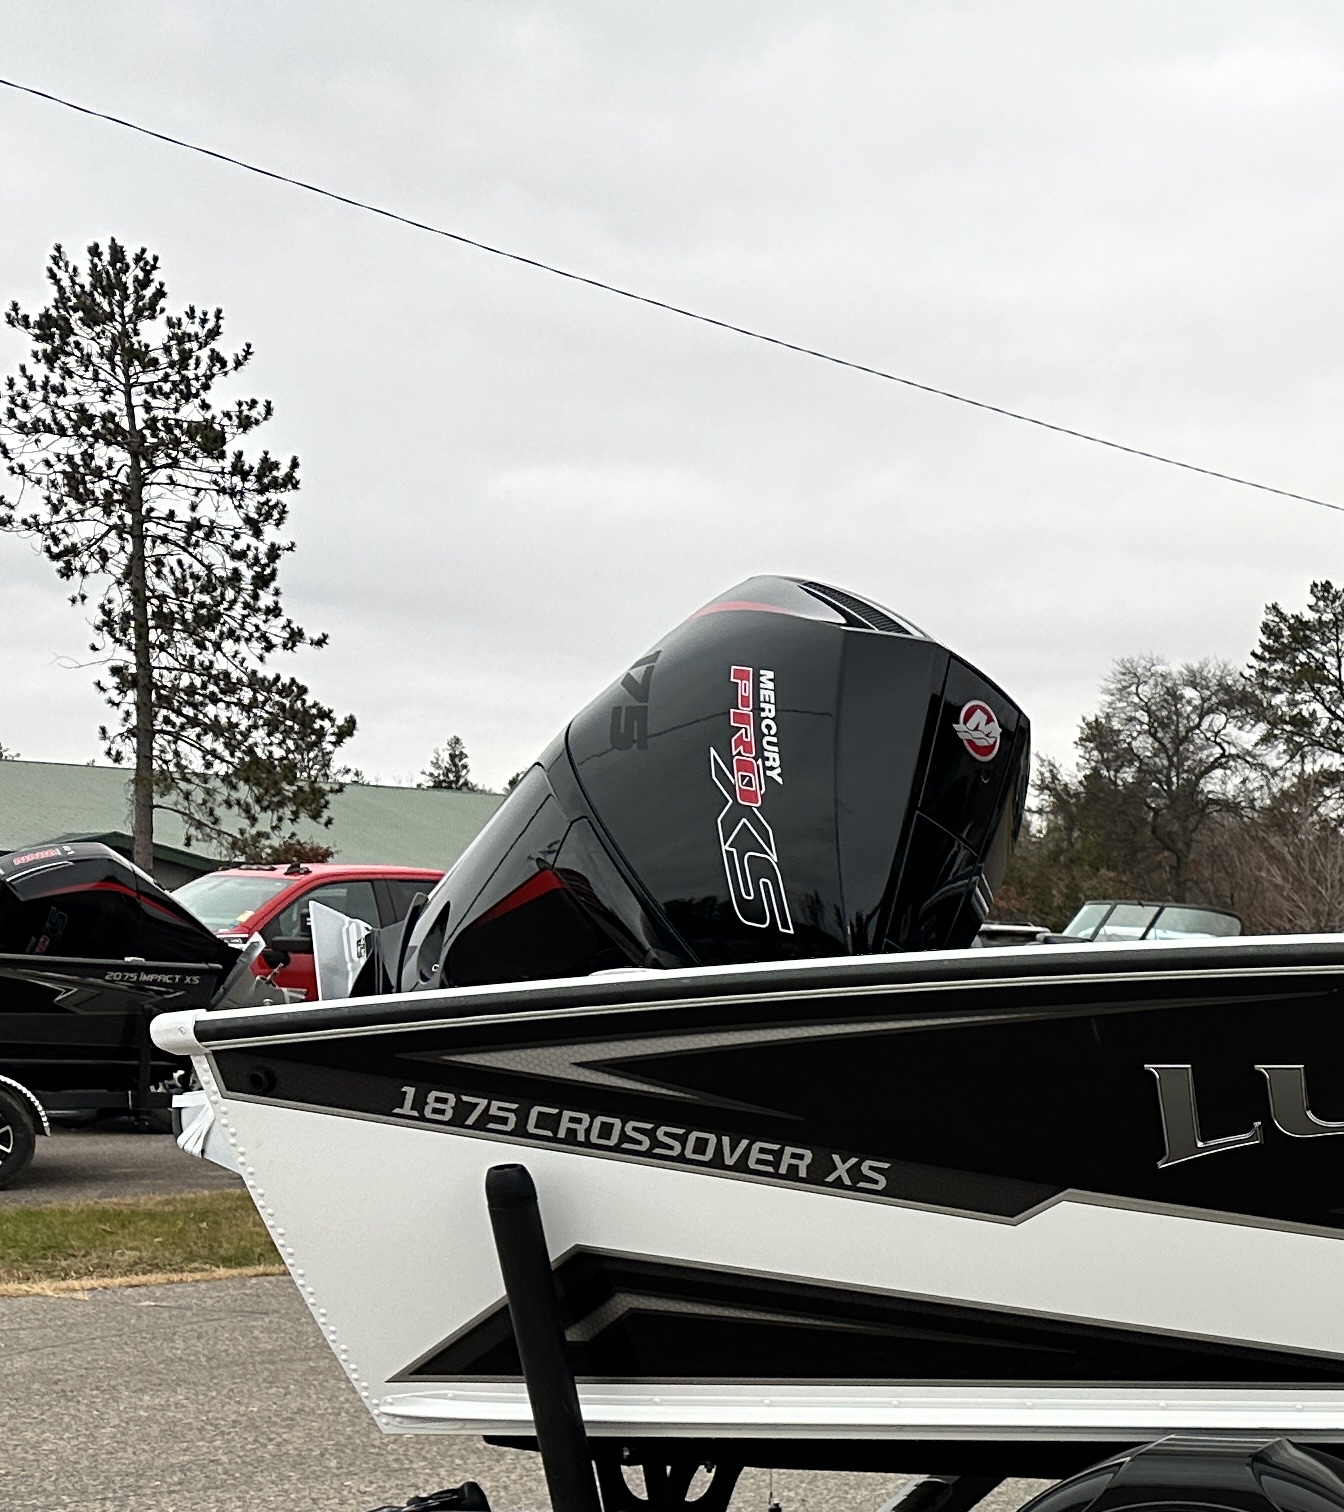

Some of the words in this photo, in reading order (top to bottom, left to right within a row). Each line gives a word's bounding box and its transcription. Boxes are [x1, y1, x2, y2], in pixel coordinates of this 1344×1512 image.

[729, 665, 762, 807] PRO
[759, 669, 783, 785] MERCURY
[709, 746, 794, 934] XS
[104, 971, 138, 982] 2075
[138, 971, 182, 984] IMPACT
[184, 974, 201, 985] XS
[391, 1085, 519, 1133] 1875
[526, 1106, 813, 1179] CROSSOVER
[825, 1153, 892, 1191] XS
